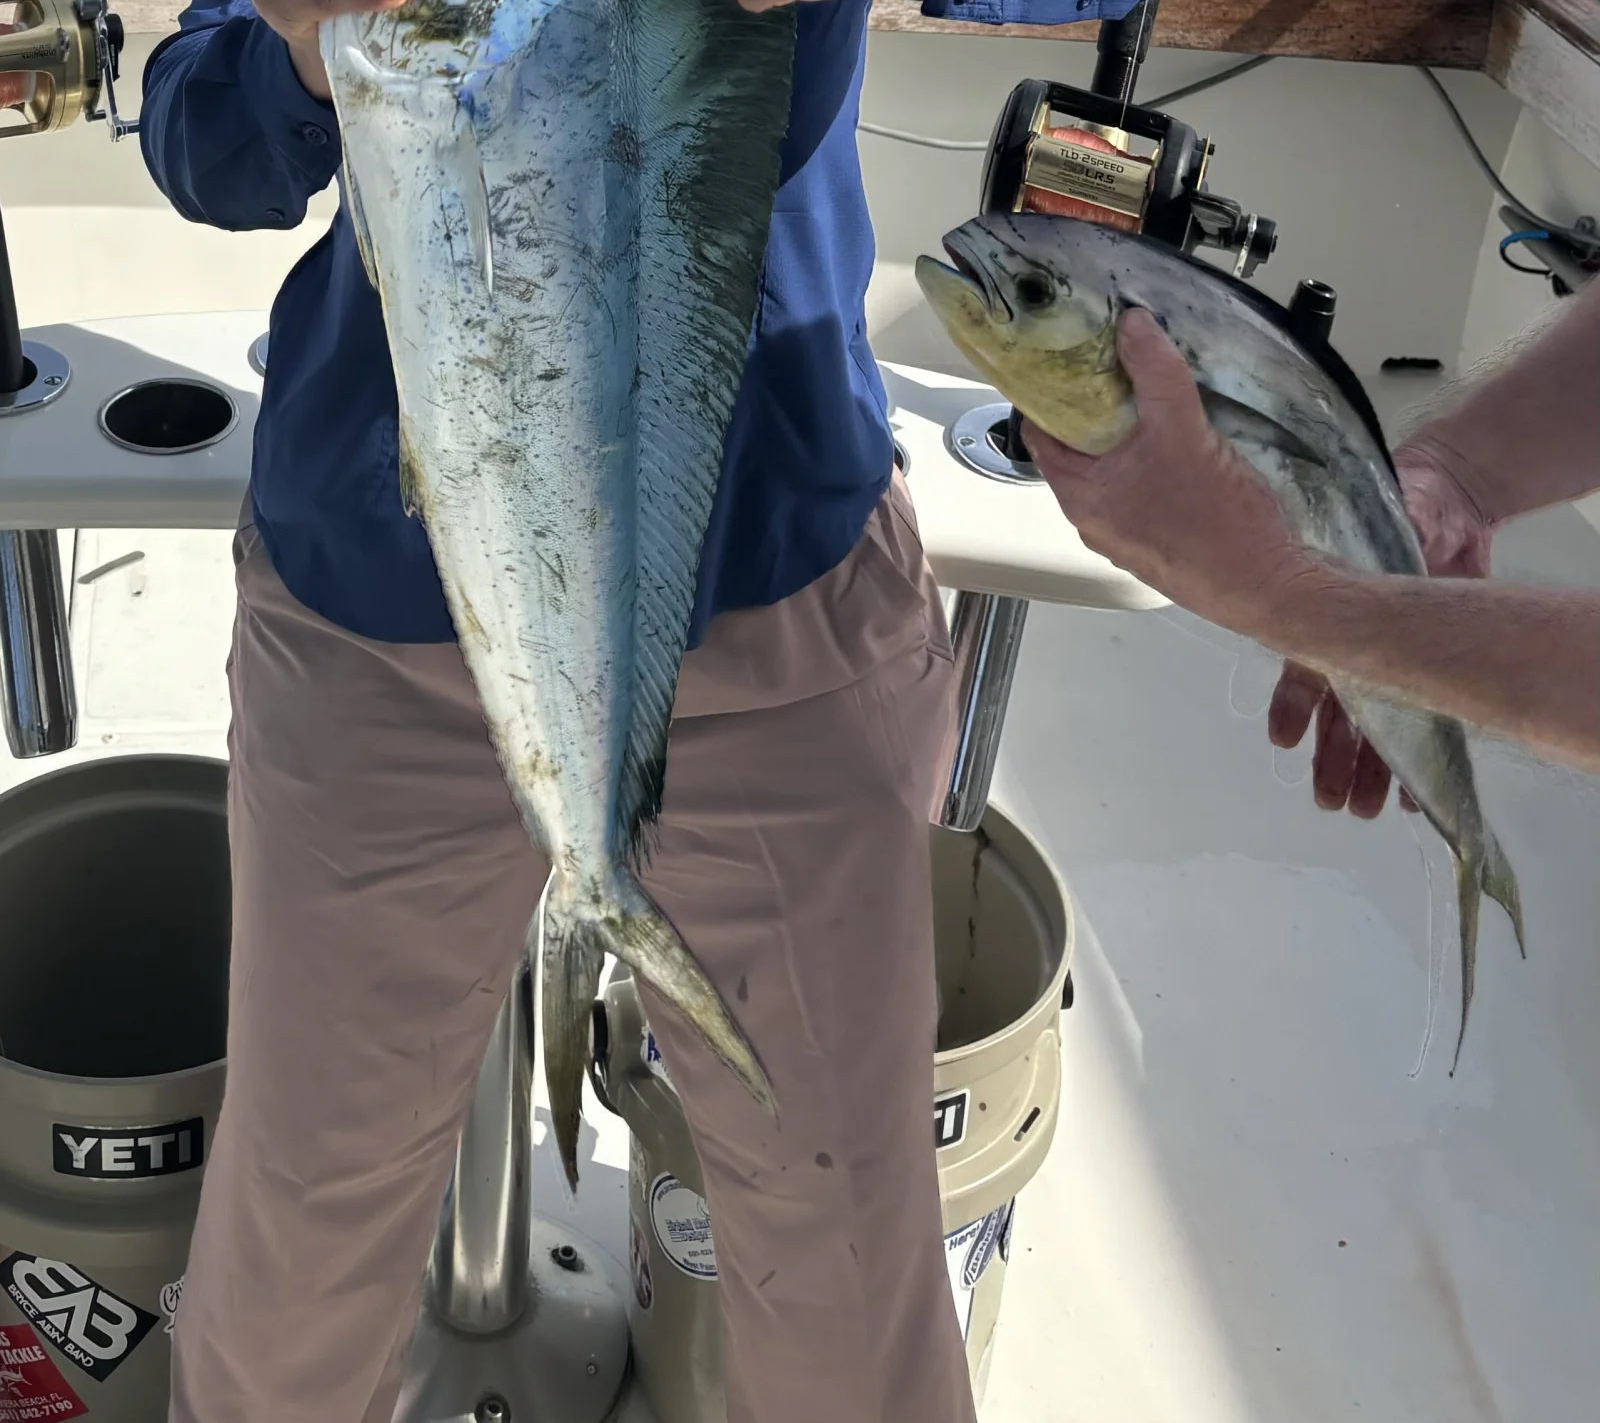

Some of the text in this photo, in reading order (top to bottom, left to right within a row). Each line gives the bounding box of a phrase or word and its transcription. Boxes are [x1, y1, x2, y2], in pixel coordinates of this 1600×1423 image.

[58, 1129, 192, 1171] YETI
[8, 1283, 39, 1319] BRYCE
[64, 1342, 94, 1367] BAND
[20, 1400, 73, 1419] 842-7190
[50, 1392, 63, 1401] FL
